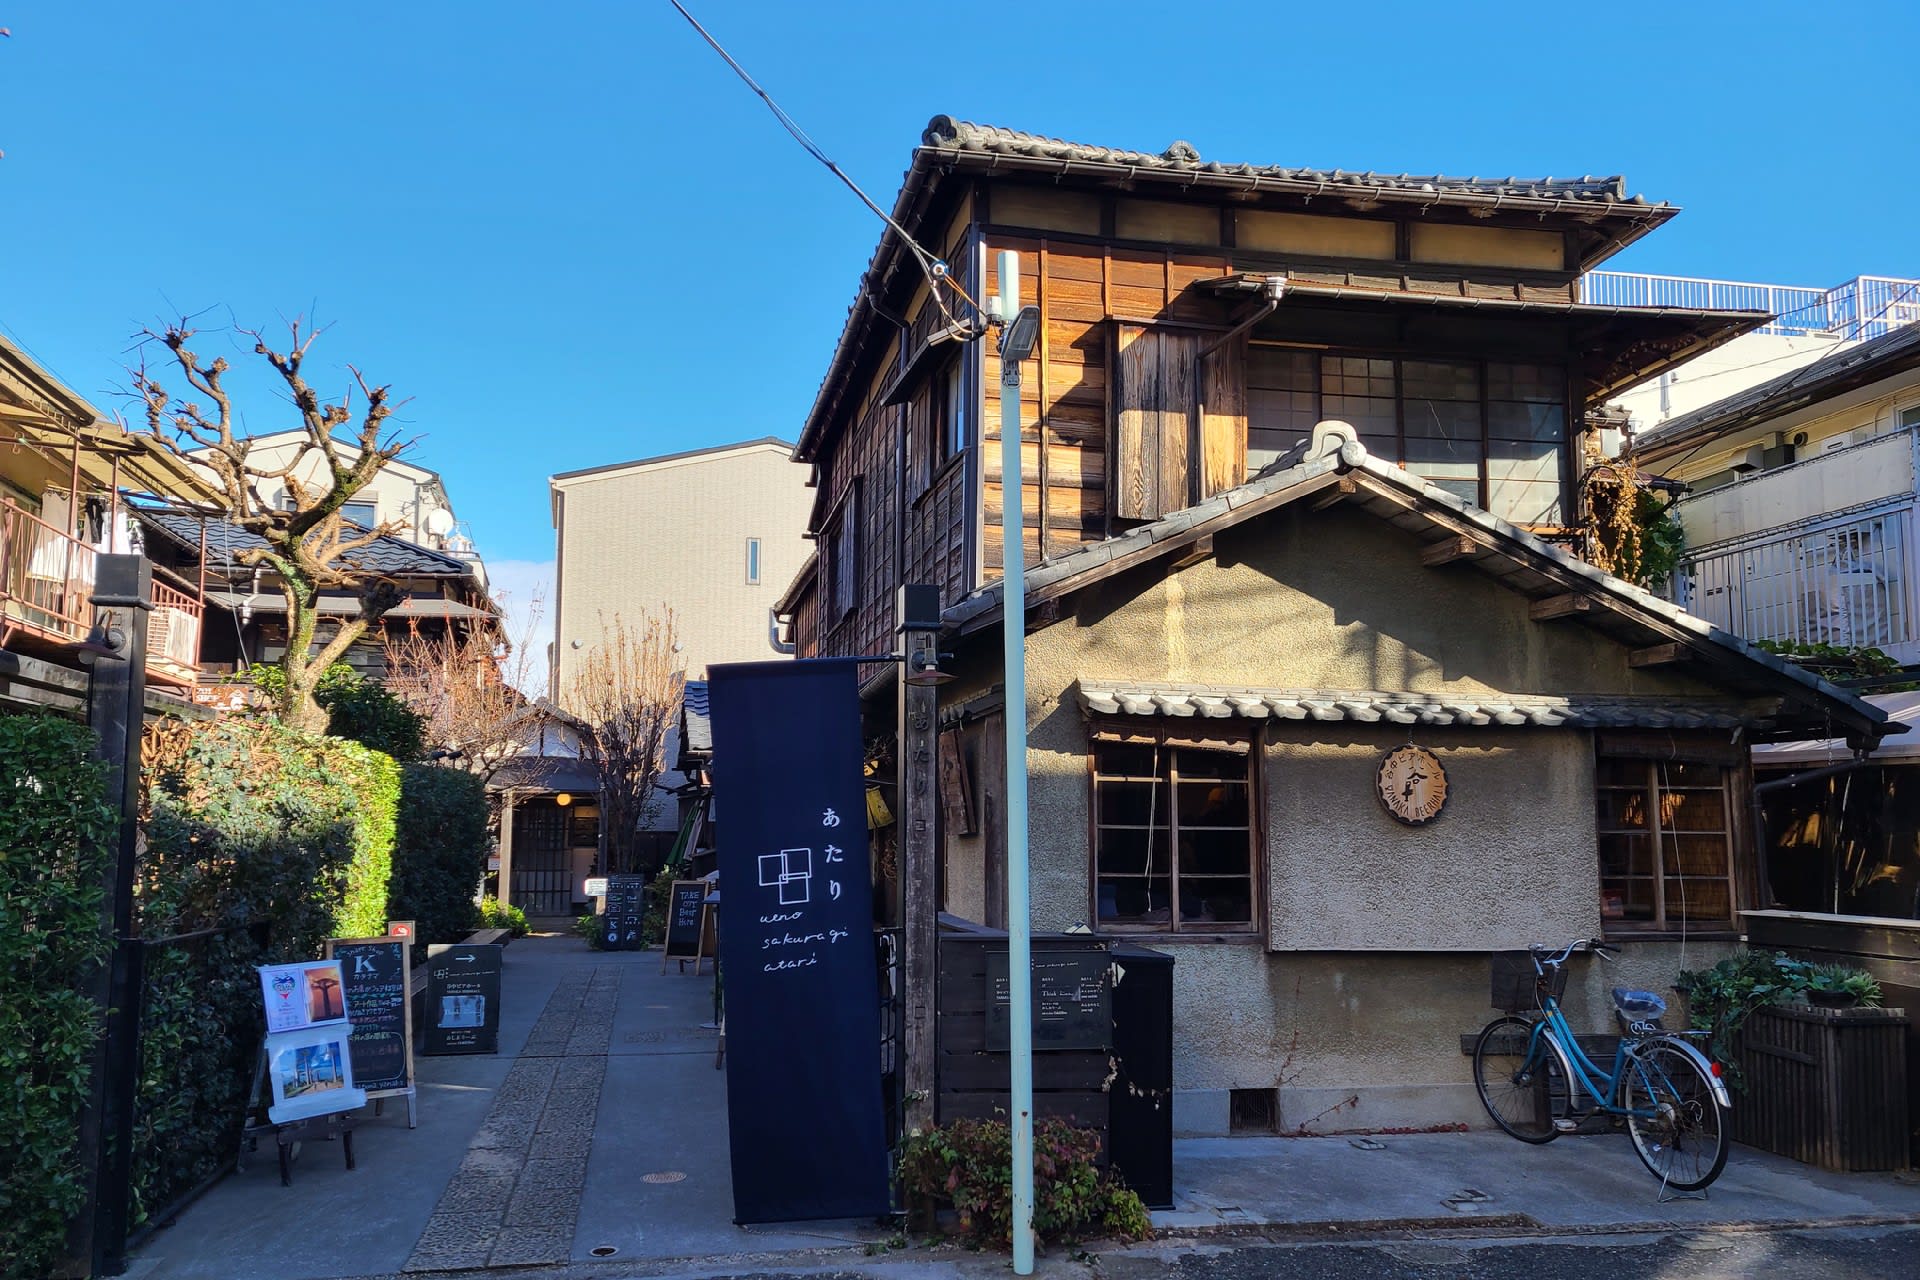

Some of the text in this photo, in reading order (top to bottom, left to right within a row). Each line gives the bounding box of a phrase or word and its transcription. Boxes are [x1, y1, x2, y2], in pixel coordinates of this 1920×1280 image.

[913, 716, 931, 796] あたり
[1385, 752, 1441, 780] 谷中ビアホール
[1384, 785, 1409, 816] YANAKA
[822, 807, 844, 901] あたり
[679, 891, 701, 900] TAKE
[759, 911, 804, 924] ueno
[354, 954, 377, 974] K
[763, 952, 818, 972] atari
